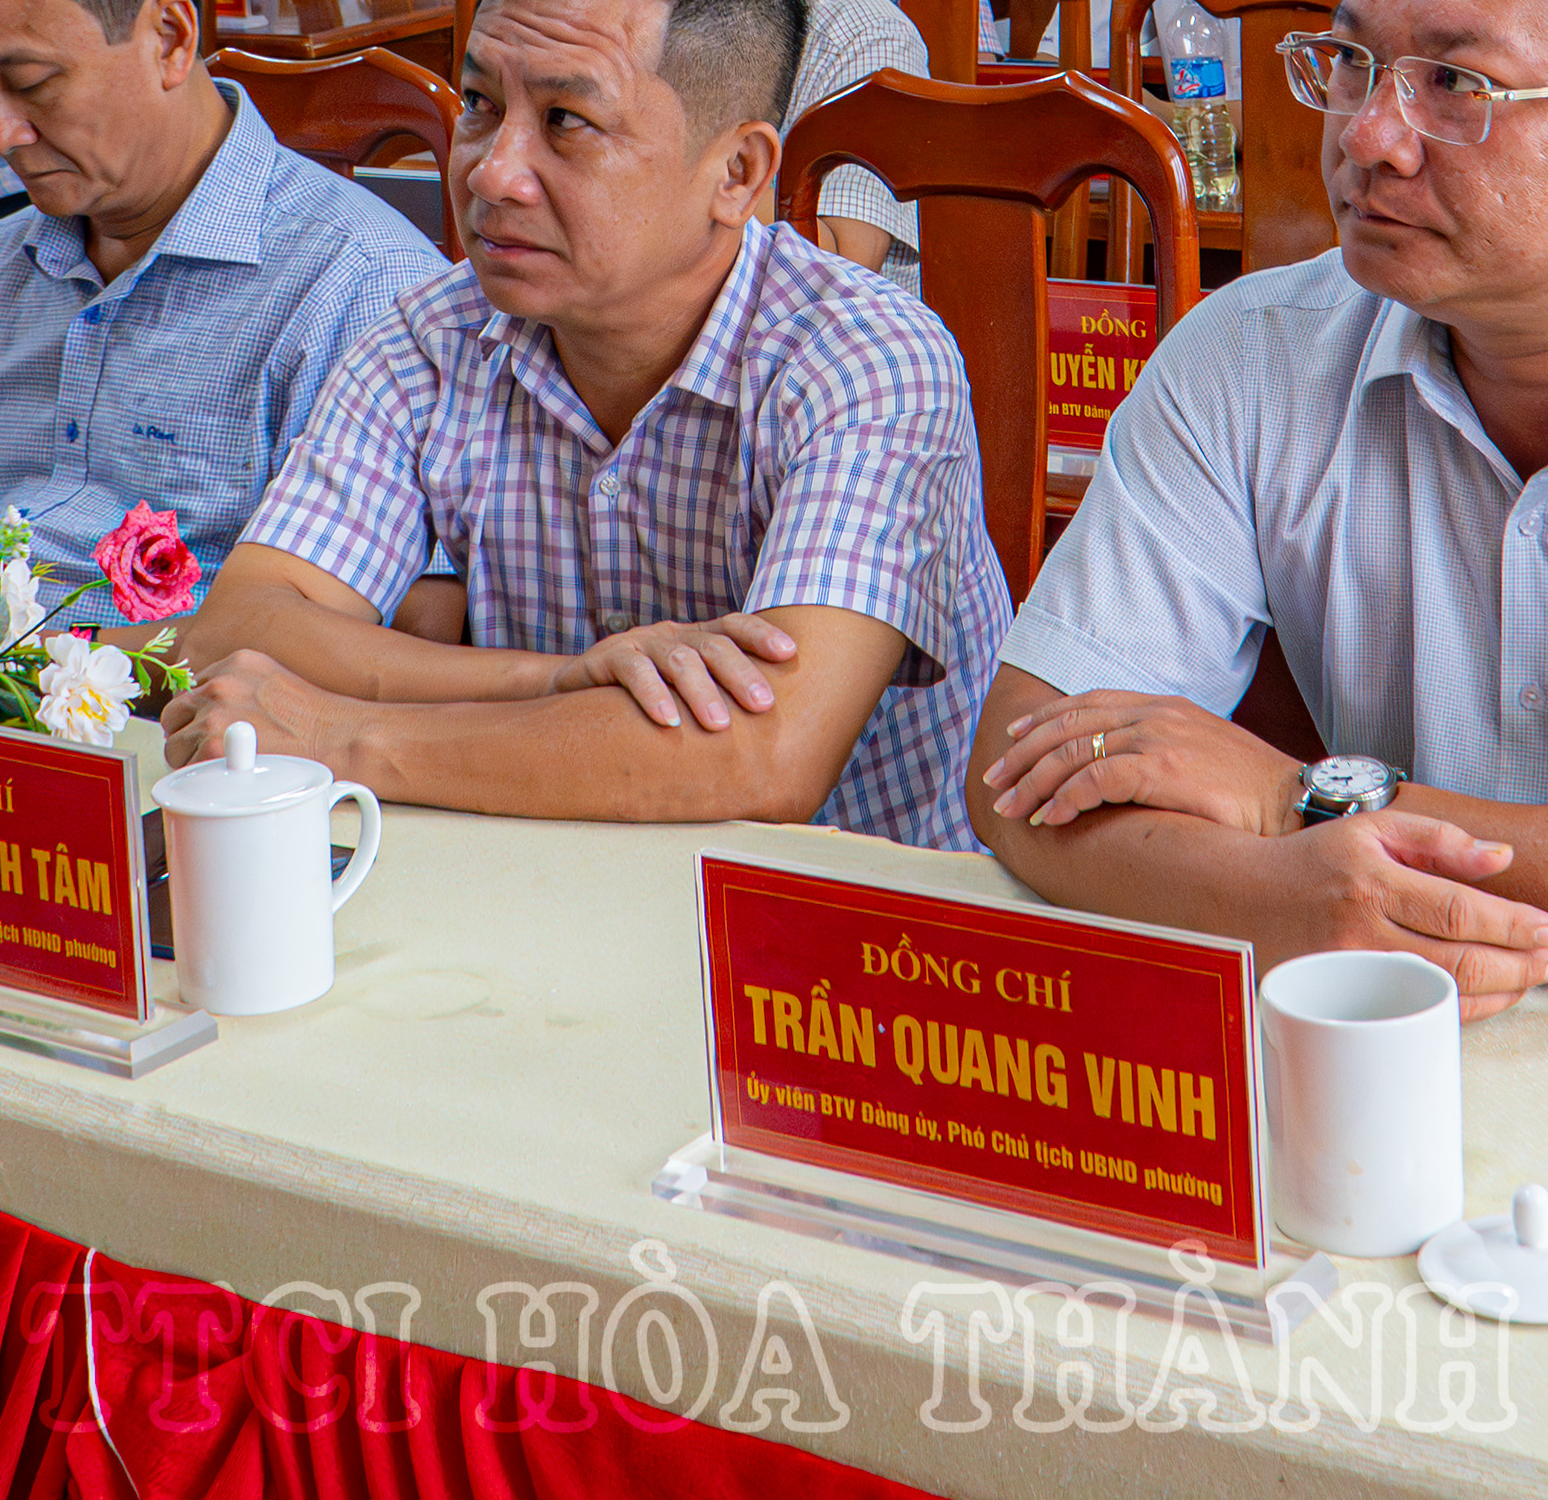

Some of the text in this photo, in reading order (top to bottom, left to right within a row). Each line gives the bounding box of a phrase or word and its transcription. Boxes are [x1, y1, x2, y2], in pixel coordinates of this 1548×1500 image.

[1081, 308, 1147, 338] ĐỒNG
[1050, 342, 1116, 391] UYỄN
[1061, 403, 1082, 417] BTV
[31, 842, 112, 916] TÂM
[22, 927, 61, 953] HĐND
[64, 939, 116, 969] phường
[862, 933, 1072, 1012] ĐỒNG CHÍ
[743, 979, 1217, 1141] TRẦN QUANG VINH
[746, 1071, 770, 1106] Ủy
[774, 1085, 815, 1113] viên
[820, 1093, 855, 1121] BTV
[861, 1102, 910, 1136] Đảng
[947, 1120, 985, 1149] Phó
[991, 1131, 1030, 1160] Chủ
[1035, 1141, 1074, 1170] tịch
[1080, 1150, 1138, 1184] UBND
[1144, 1167, 1223, 1206] phường
